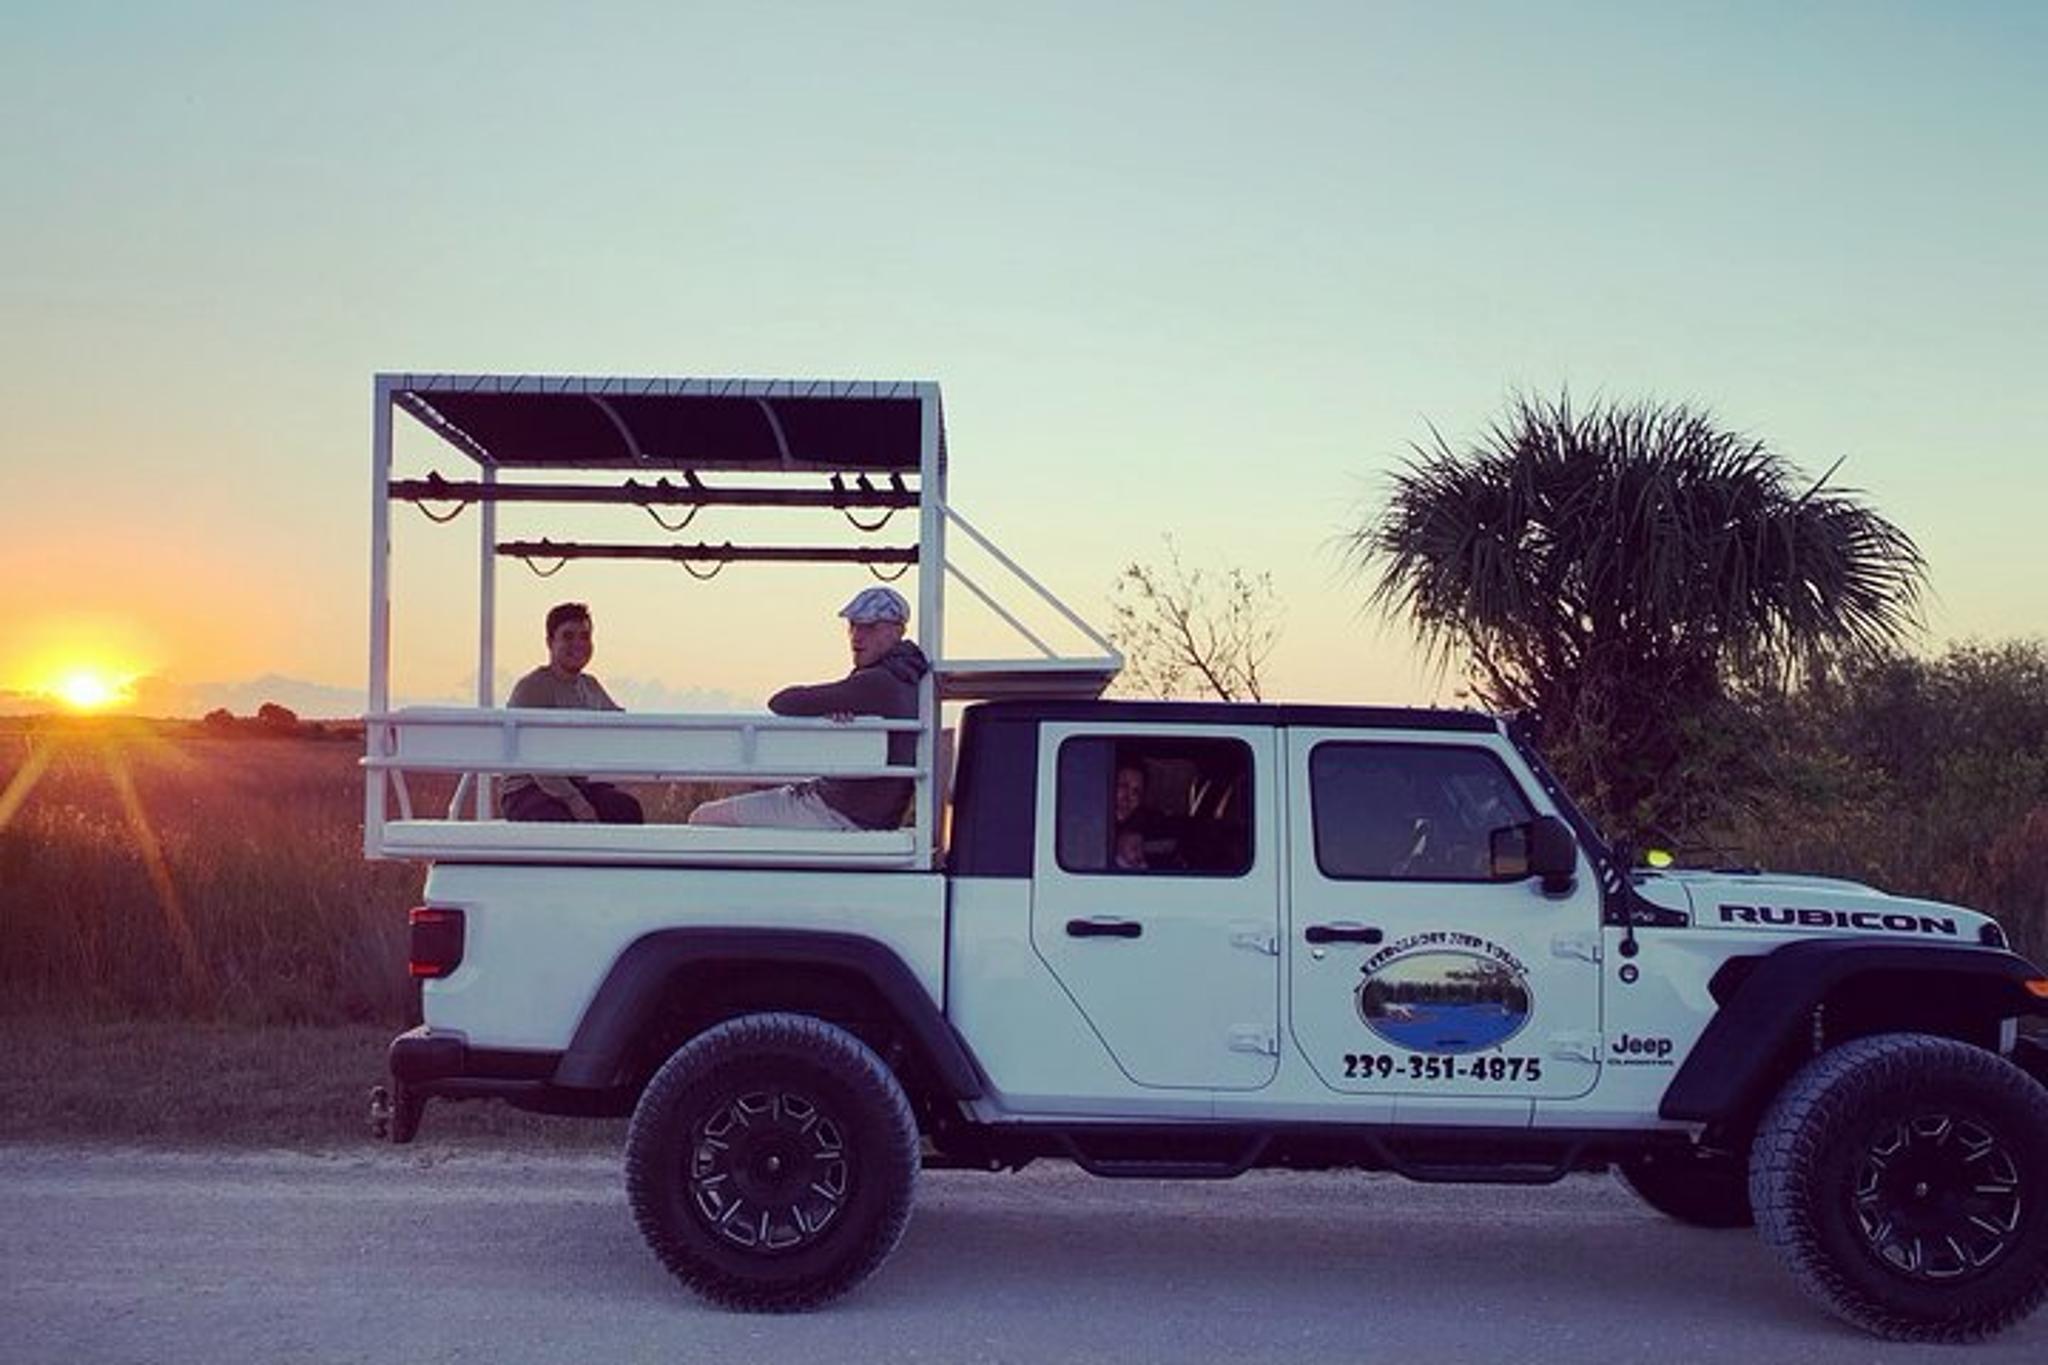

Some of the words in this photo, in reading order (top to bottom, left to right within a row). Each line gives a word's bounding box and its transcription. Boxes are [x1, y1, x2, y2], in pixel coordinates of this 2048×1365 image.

[1718, 904, 1958, 935] RUBICON
[1612, 1033, 1674, 1058] Jeep
[1344, 1054, 1542, 1082] 239-351-4875
